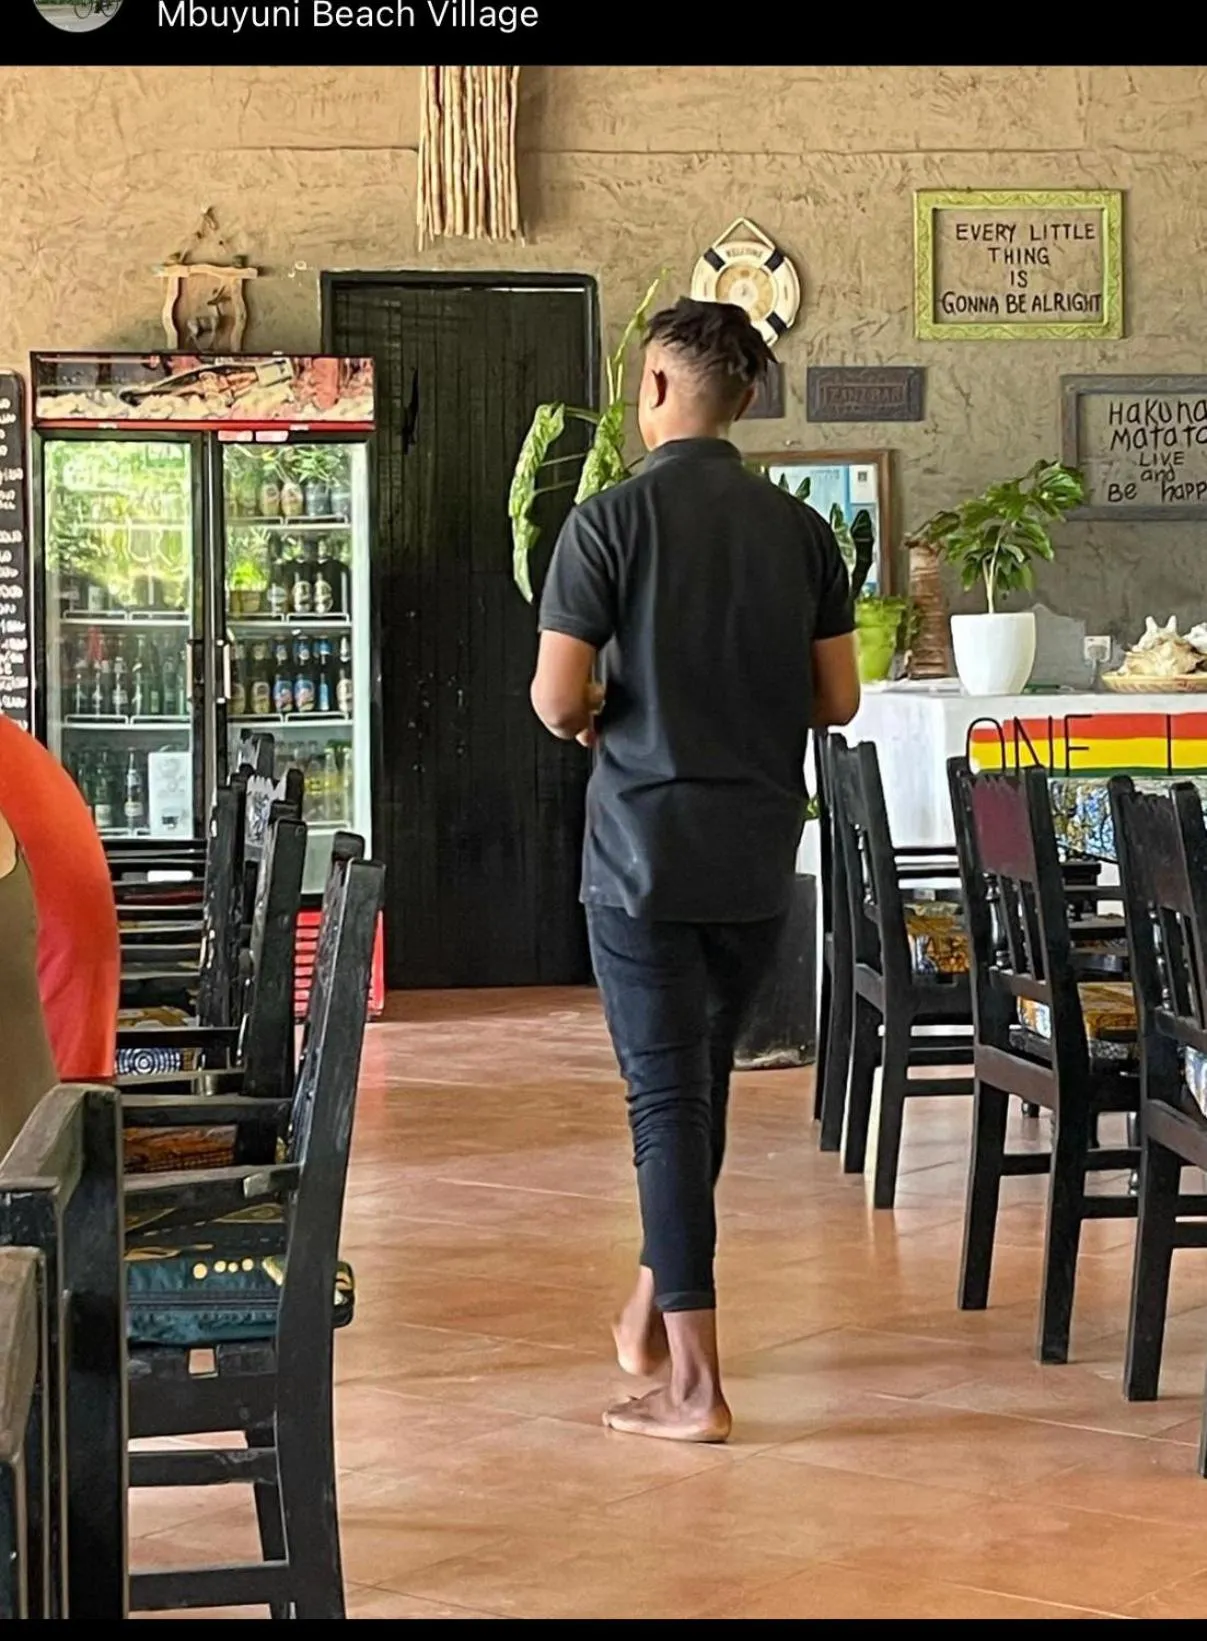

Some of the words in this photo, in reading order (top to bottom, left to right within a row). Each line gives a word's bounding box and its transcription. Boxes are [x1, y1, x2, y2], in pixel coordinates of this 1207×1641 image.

[956, 223, 1016, 243] EVERY
[1030, 223, 1096, 241] LITTLE
[988, 247, 1051, 266] THING
[1010, 270, 1028, 288] IS
[941, 291, 999, 315] GONNA
[1006, 292, 1027, 314] BE
[1031, 292, 1102, 313] ALRIGHT
[1139, 451, 1185, 467] LIVE
[1140, 464, 1176, 482] and
[1107, 482, 1138, 502] Be
[1161, 480, 1207, 503] happ
